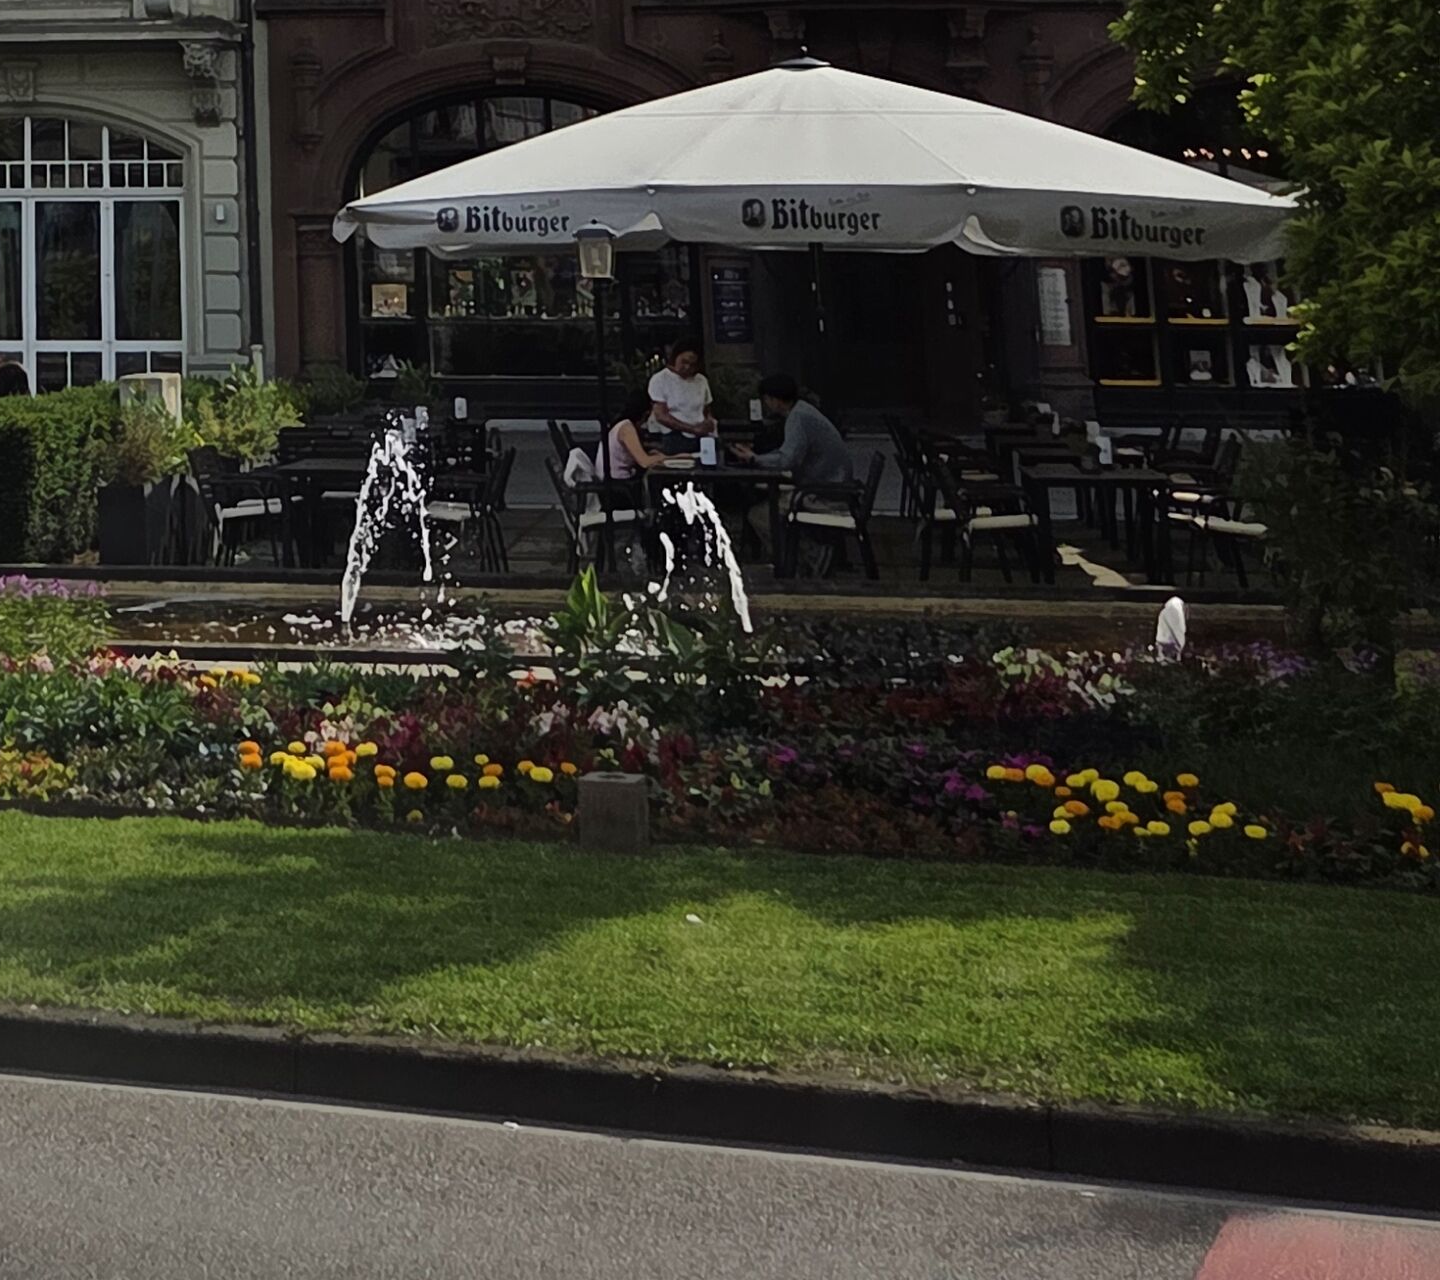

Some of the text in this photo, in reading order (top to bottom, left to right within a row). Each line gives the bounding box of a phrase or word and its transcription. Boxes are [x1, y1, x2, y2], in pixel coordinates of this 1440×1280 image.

[464, 205, 570, 237] Bitburger
[771, 198, 882, 236] Bitburger
[1090, 206, 1206, 249] Bitburger
